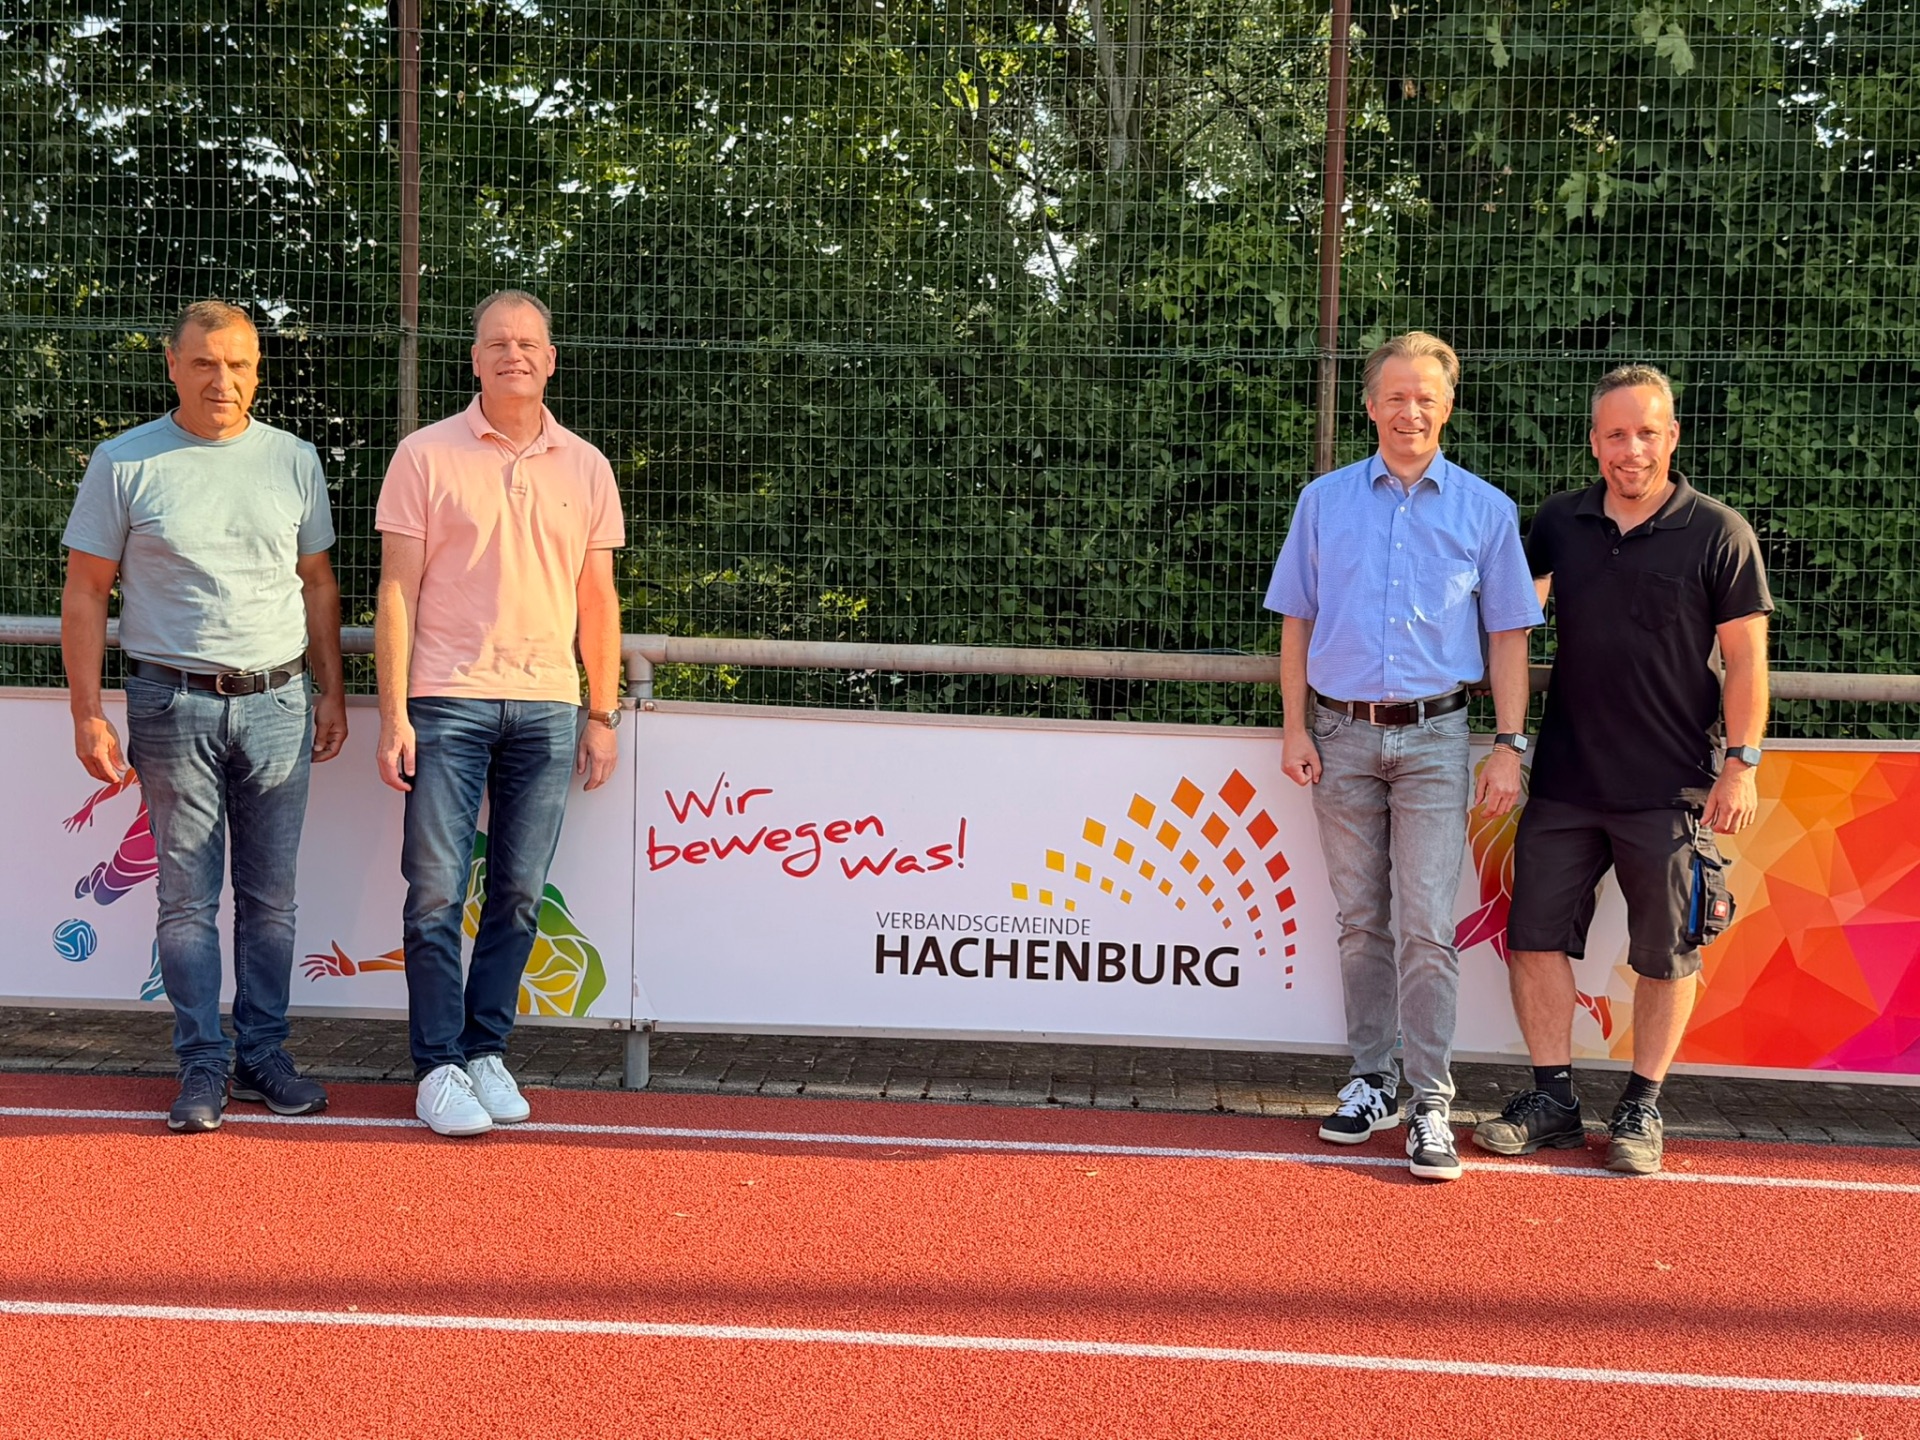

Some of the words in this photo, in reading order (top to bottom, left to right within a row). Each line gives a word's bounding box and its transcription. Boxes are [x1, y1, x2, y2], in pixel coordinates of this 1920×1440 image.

[664, 771, 773, 824] Wir
[646, 813, 884, 879] bewegen
[840, 818, 967, 880] was!
[876, 911, 1091, 936] VERBANDSGEMEINDE
[875, 934, 1240, 988] HACHENBURG
